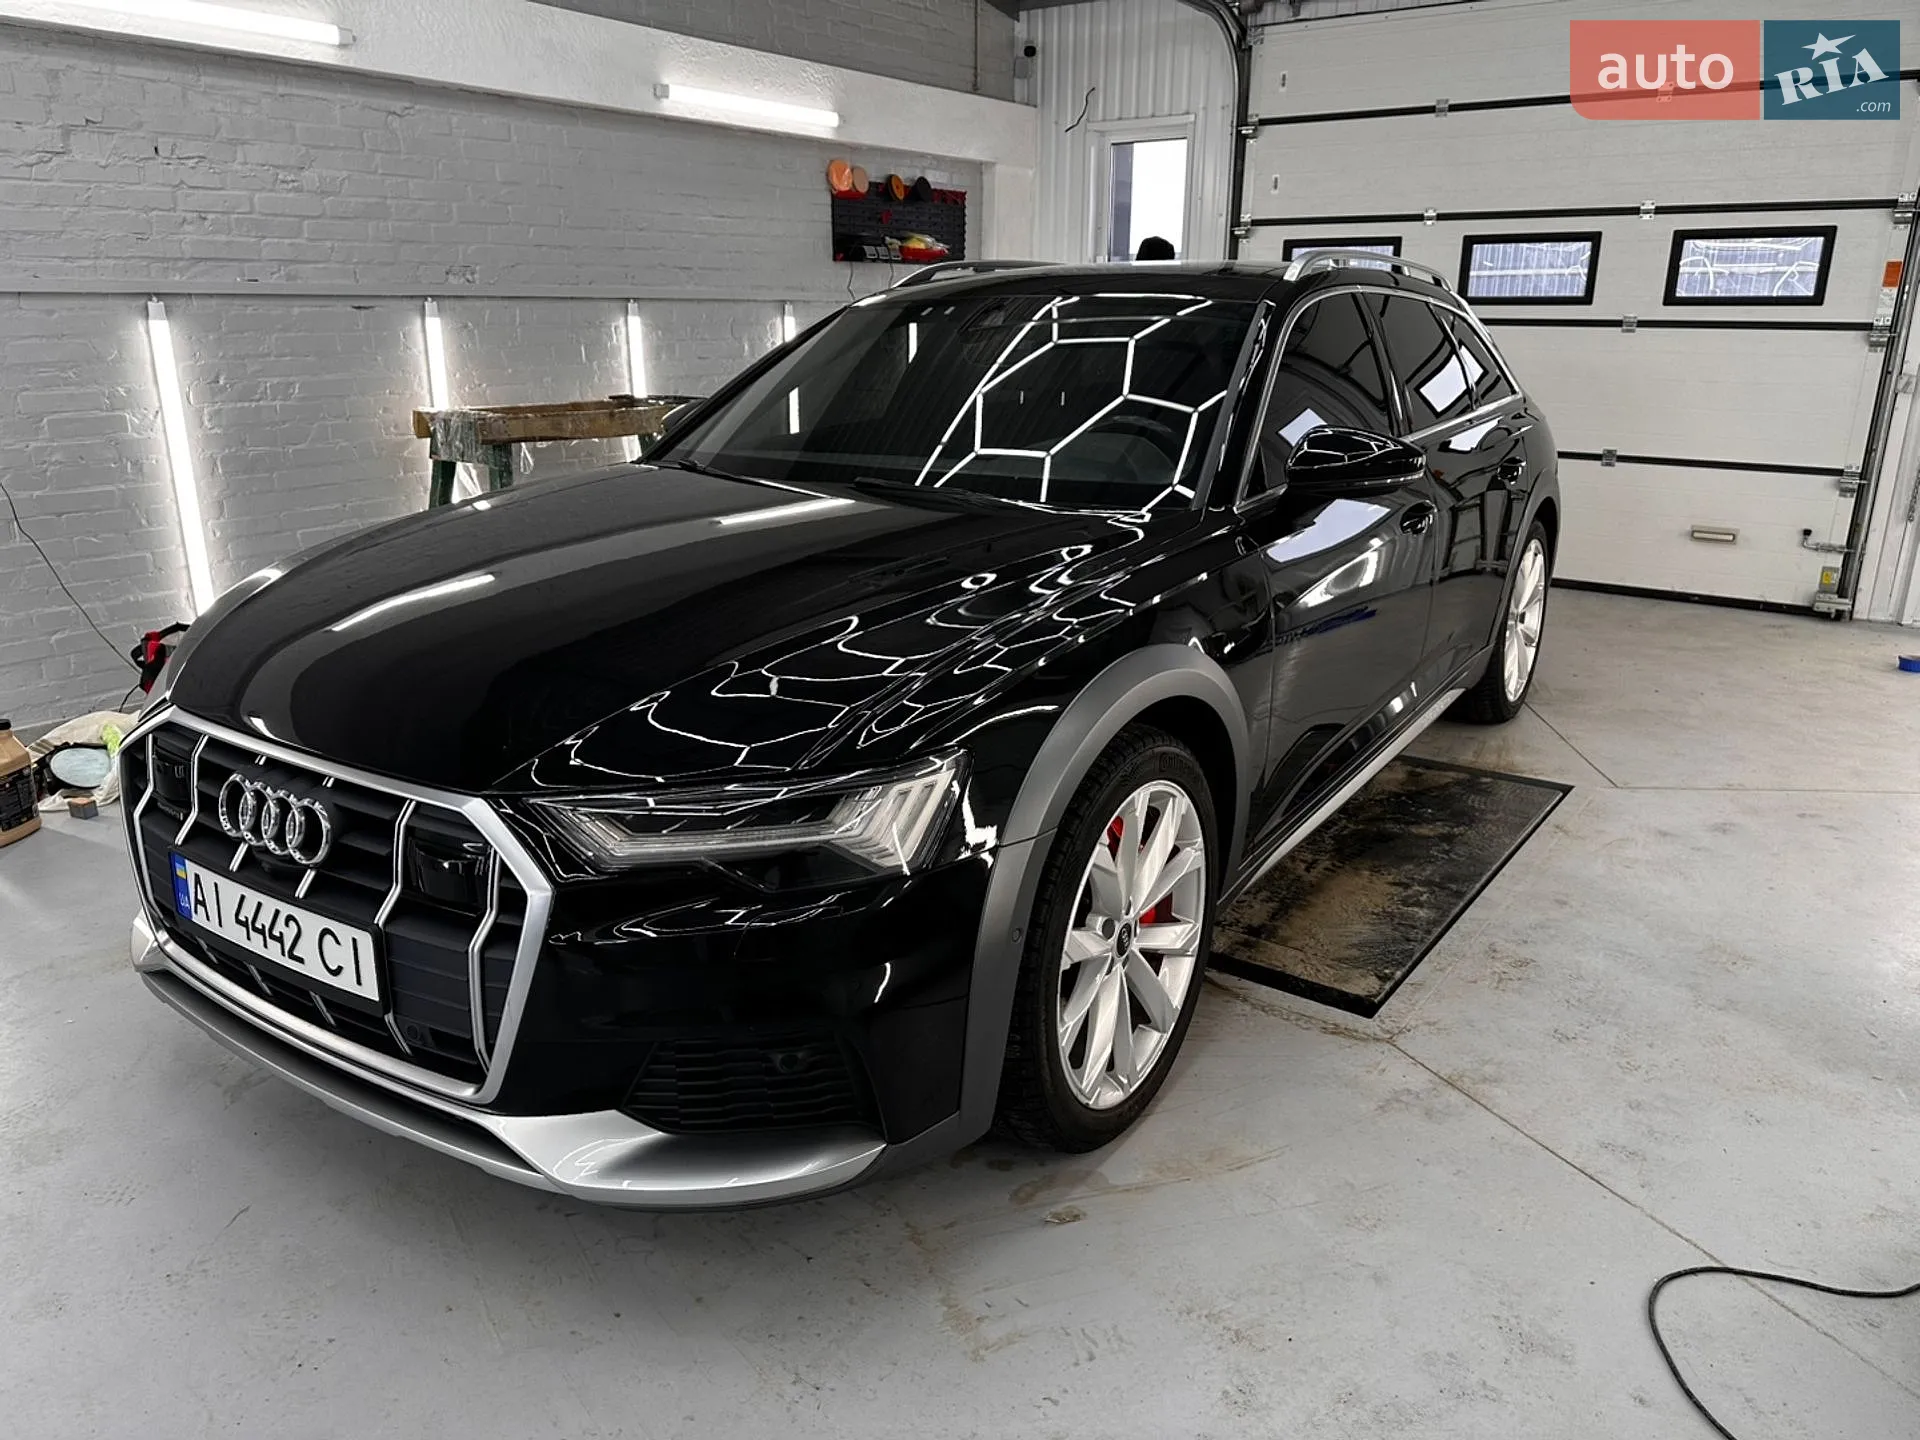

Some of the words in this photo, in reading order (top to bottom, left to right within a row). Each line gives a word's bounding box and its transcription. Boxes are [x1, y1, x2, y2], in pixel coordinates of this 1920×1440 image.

[194, 872, 222, 928] AI
[234, 894, 305, 965] 4442
[318, 927, 362, 986] CI
